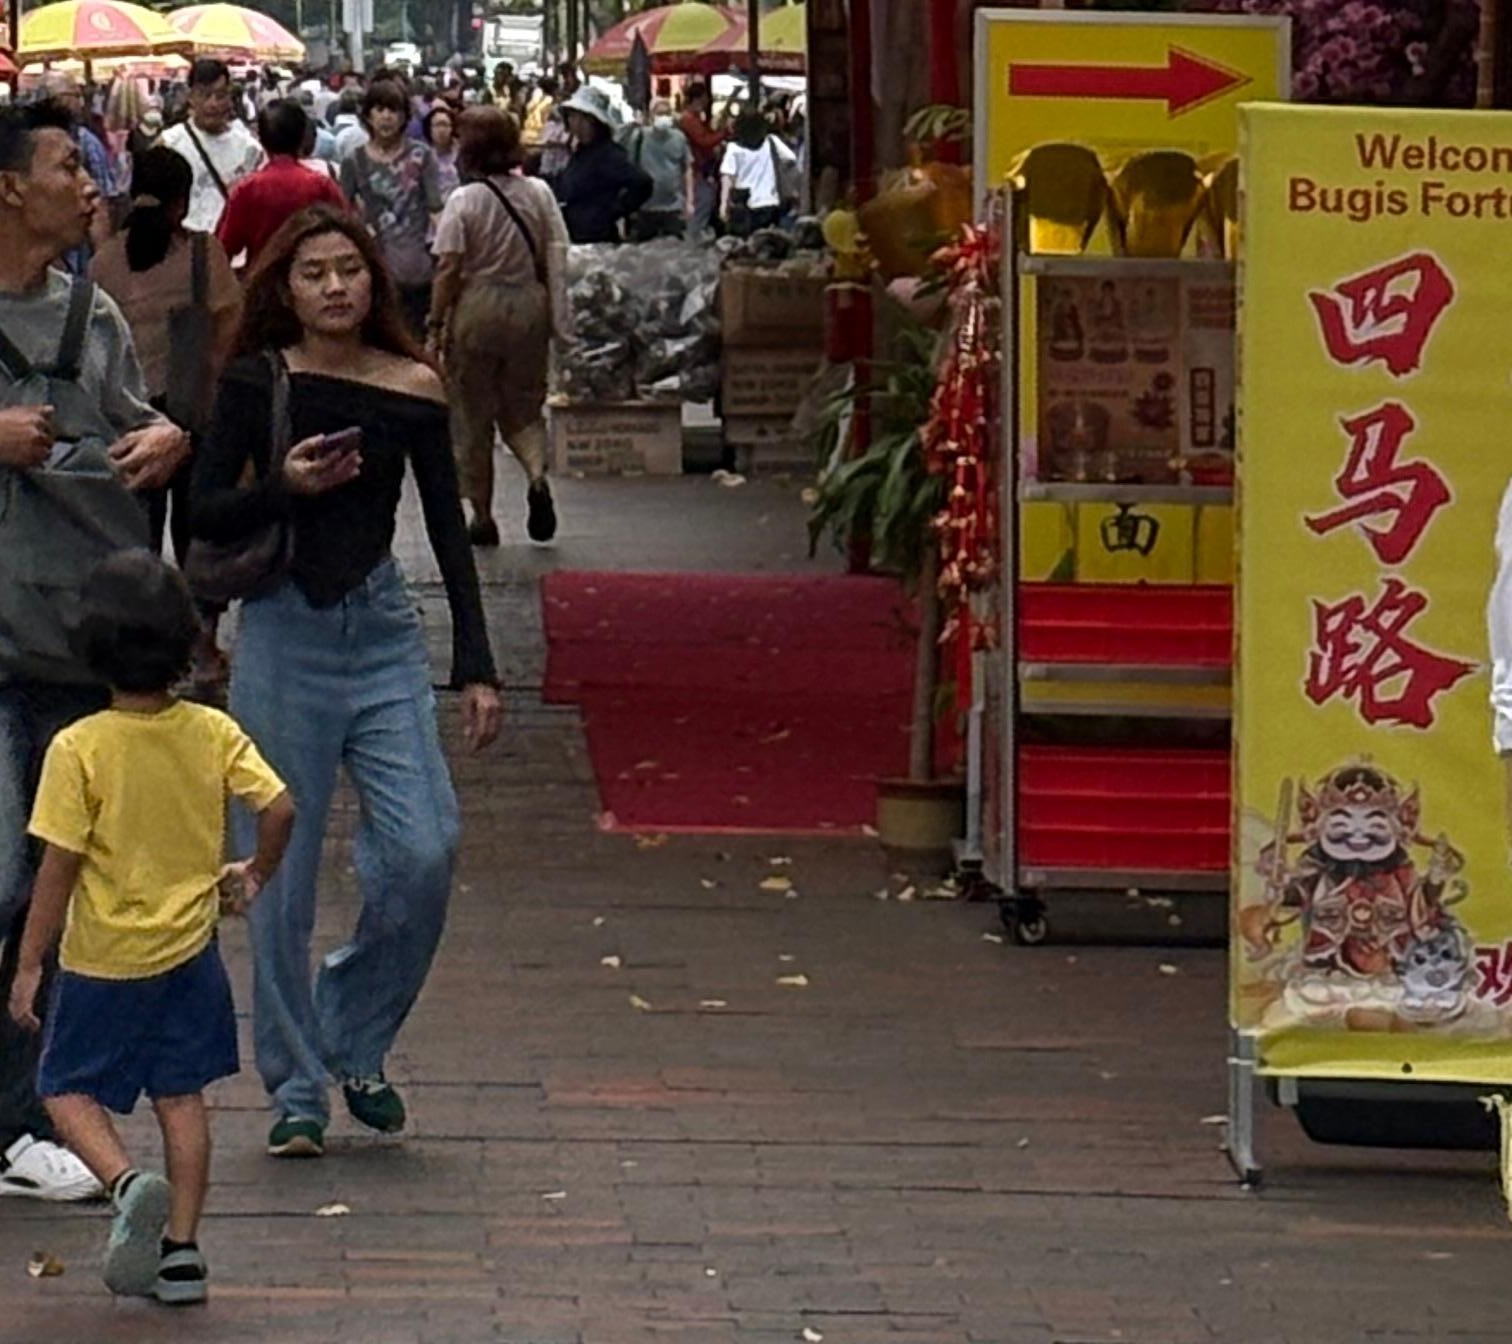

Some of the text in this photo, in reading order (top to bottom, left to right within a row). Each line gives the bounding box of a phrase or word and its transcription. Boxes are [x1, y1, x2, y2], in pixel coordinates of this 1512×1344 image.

[1289, 177, 1512, 223] Bugis Fort
[1302, 250, 1481, 728] 四马路
